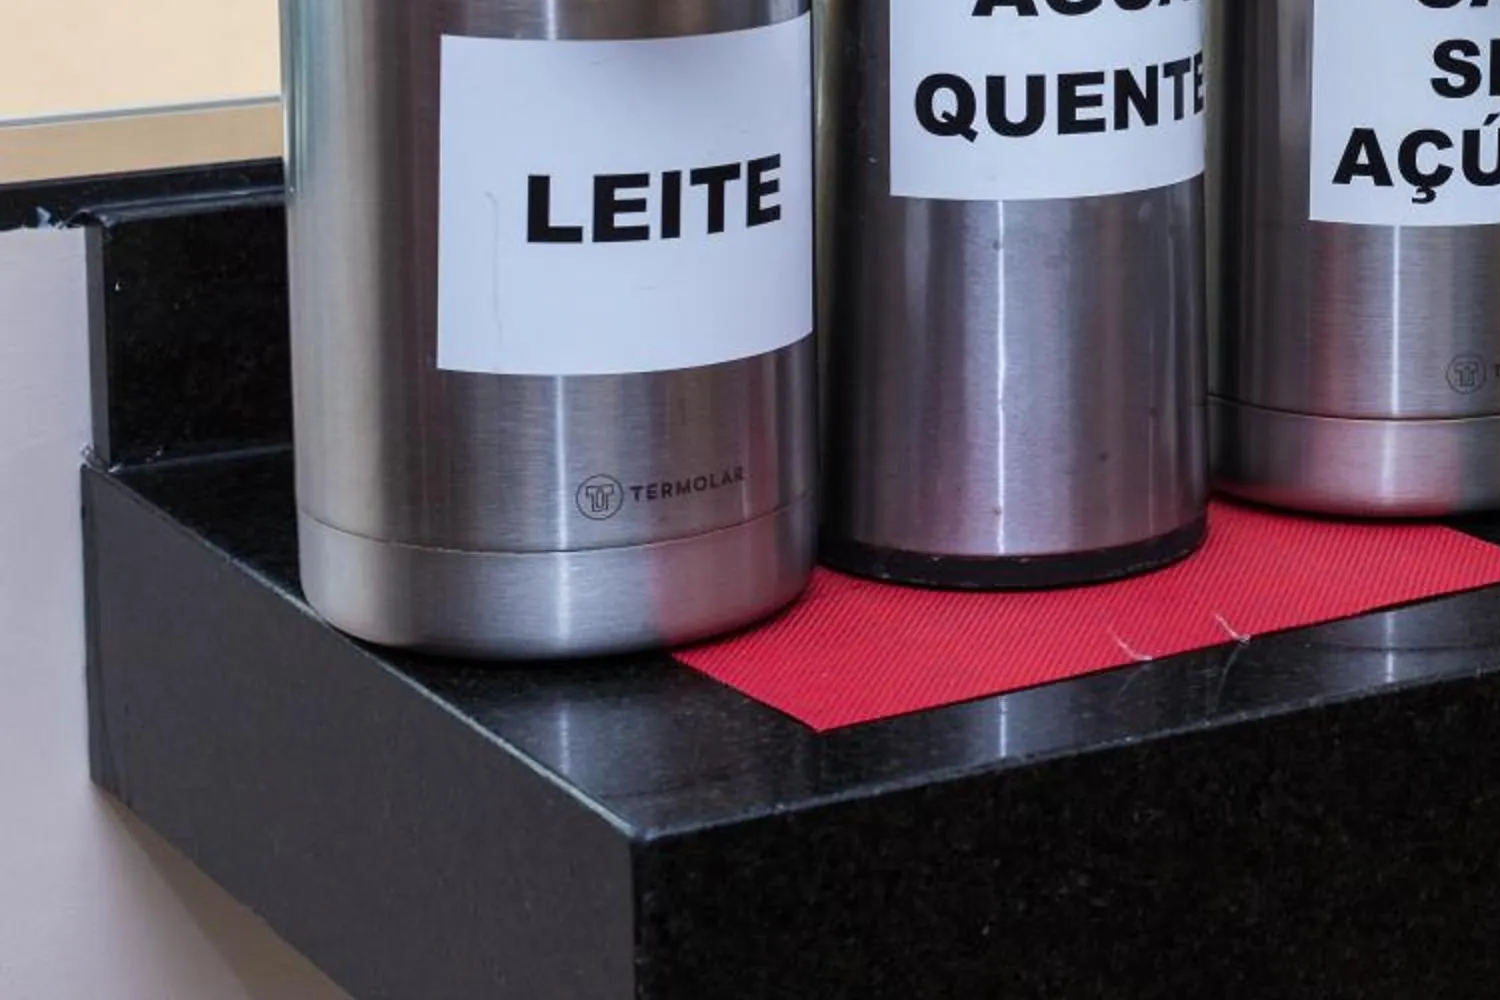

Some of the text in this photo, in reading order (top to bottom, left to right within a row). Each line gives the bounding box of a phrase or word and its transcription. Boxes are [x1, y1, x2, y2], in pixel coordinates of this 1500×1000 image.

[915, 51, 1204, 142] QUENTE
[527, 153, 781, 243] LEITE
[630, 466, 745, 502] TERMOLAR
